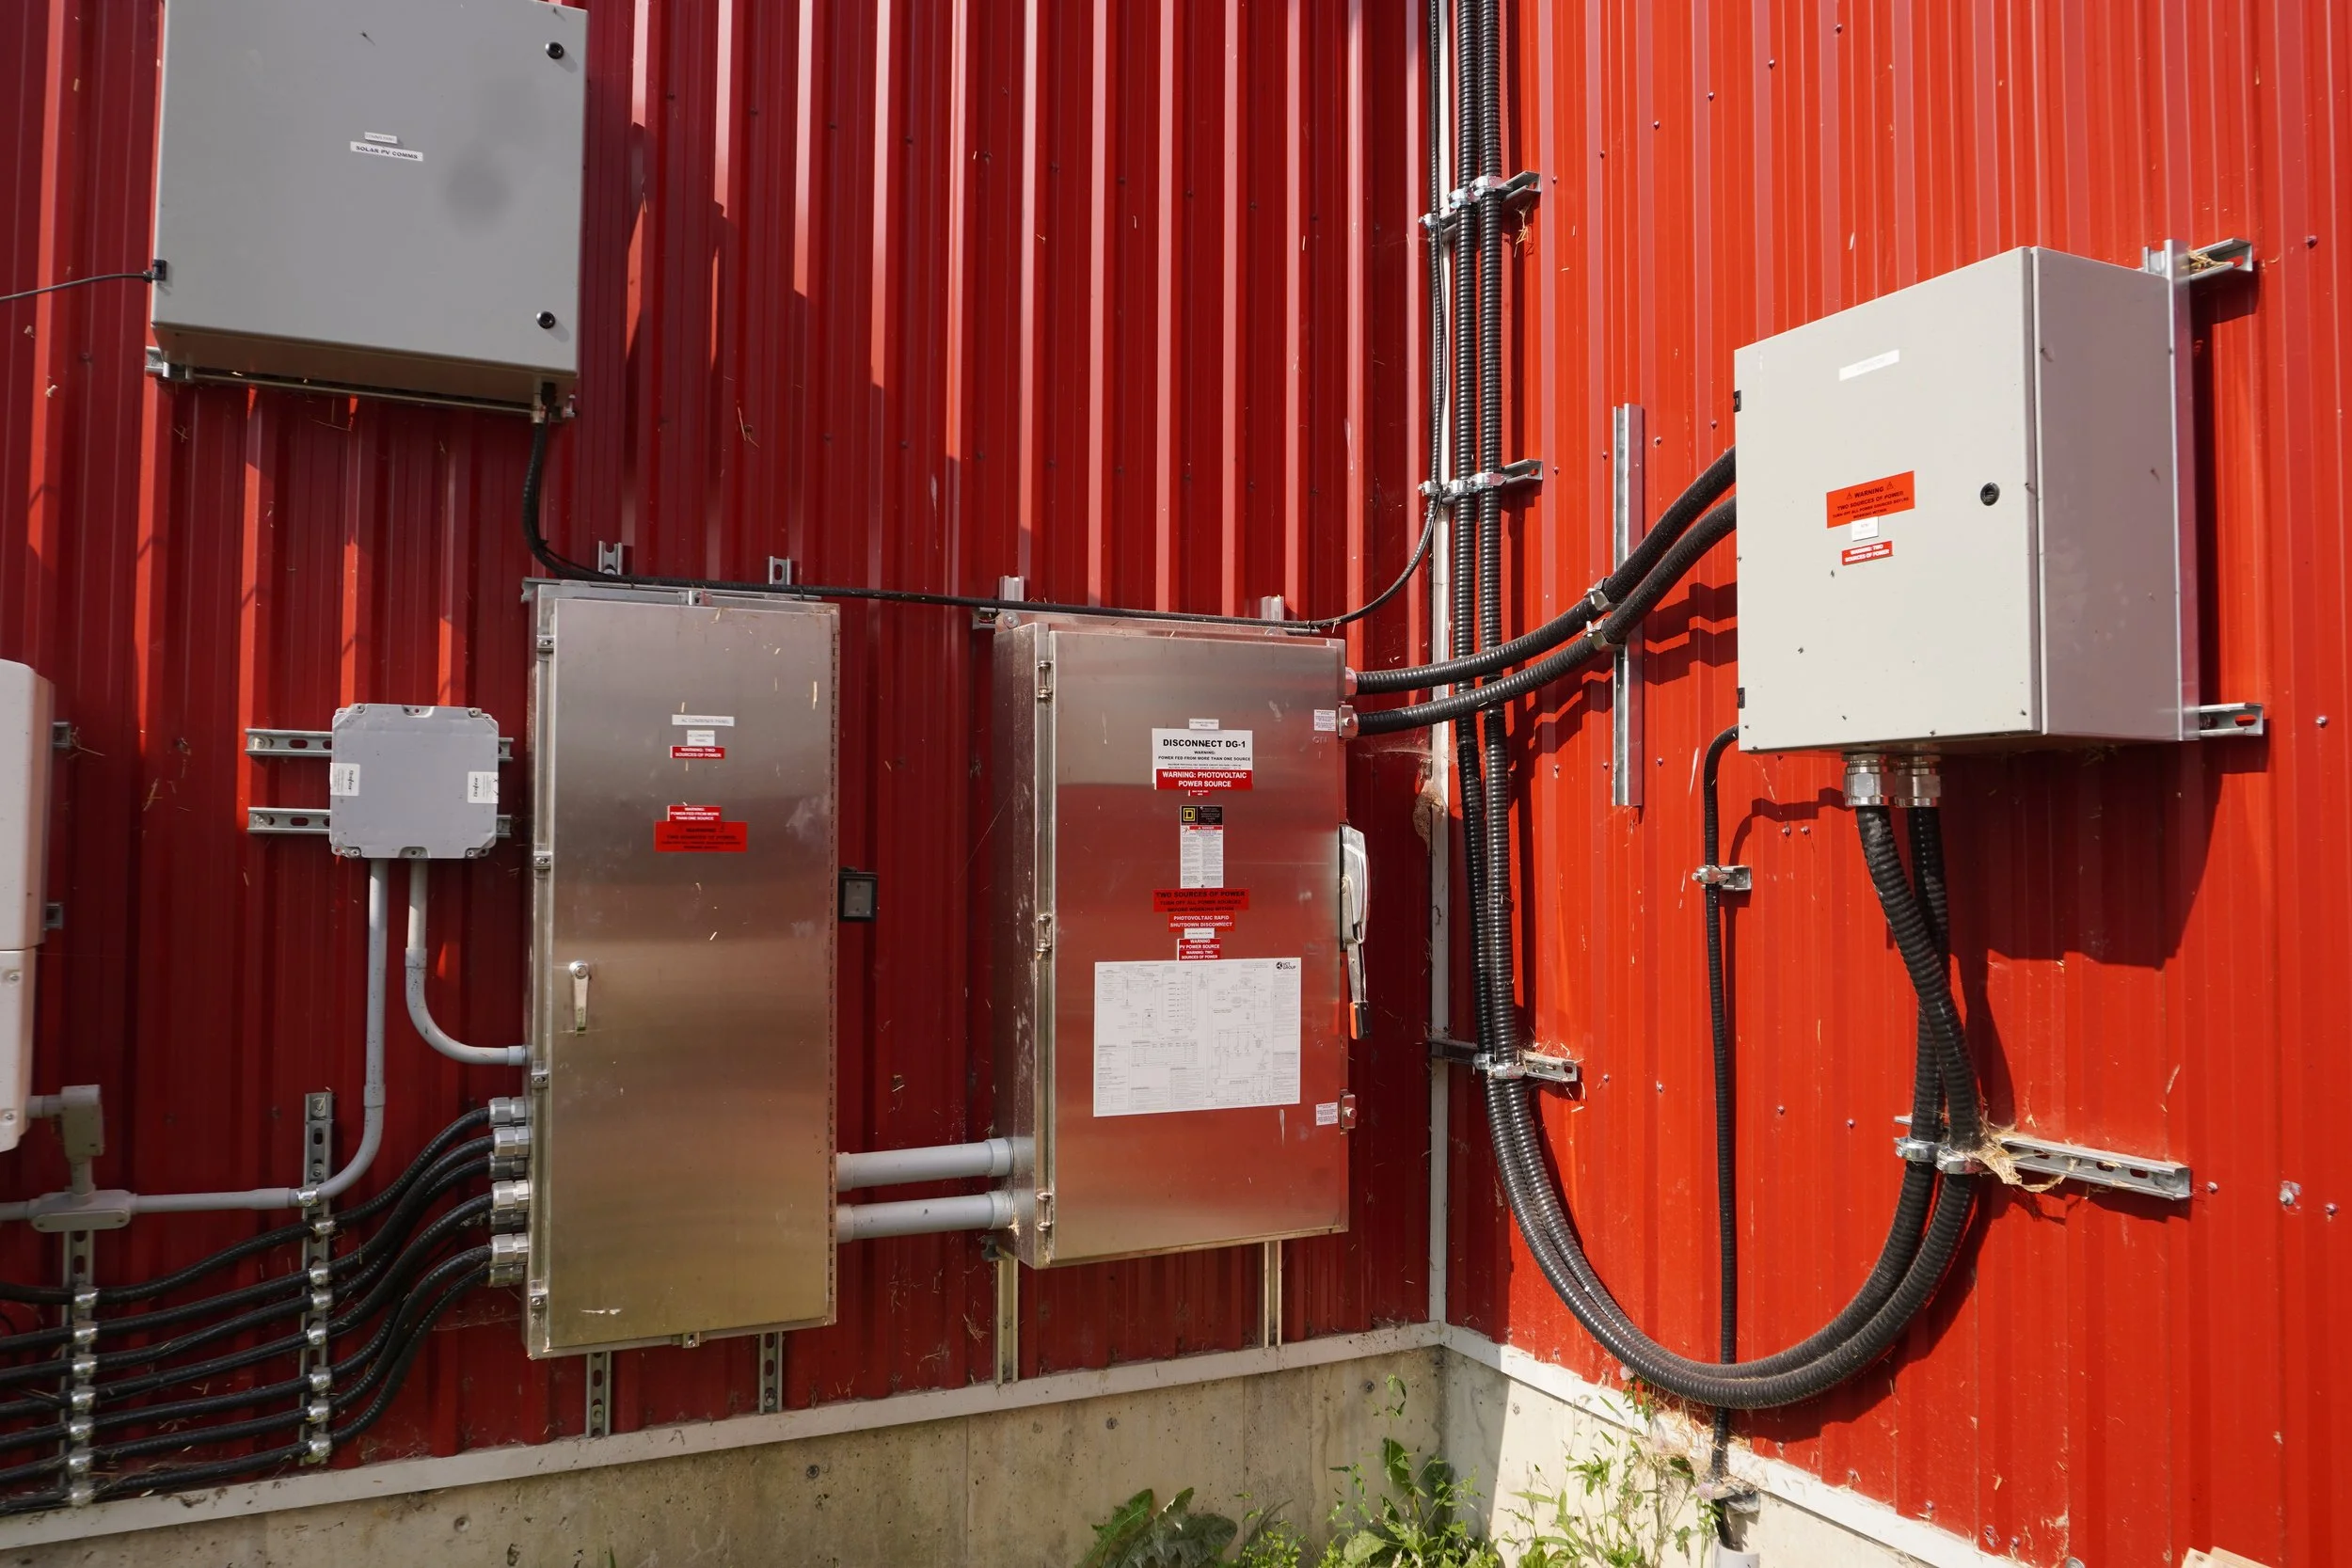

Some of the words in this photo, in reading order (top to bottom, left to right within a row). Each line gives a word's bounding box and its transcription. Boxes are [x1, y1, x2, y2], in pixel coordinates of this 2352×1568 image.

[1854, 486, 1884, 498] WARNING
[1850, 498, 1874, 508] SOURCES
[1884, 491, 1903, 499] POWER
[1163, 739, 1223, 747] DISCONNECT
